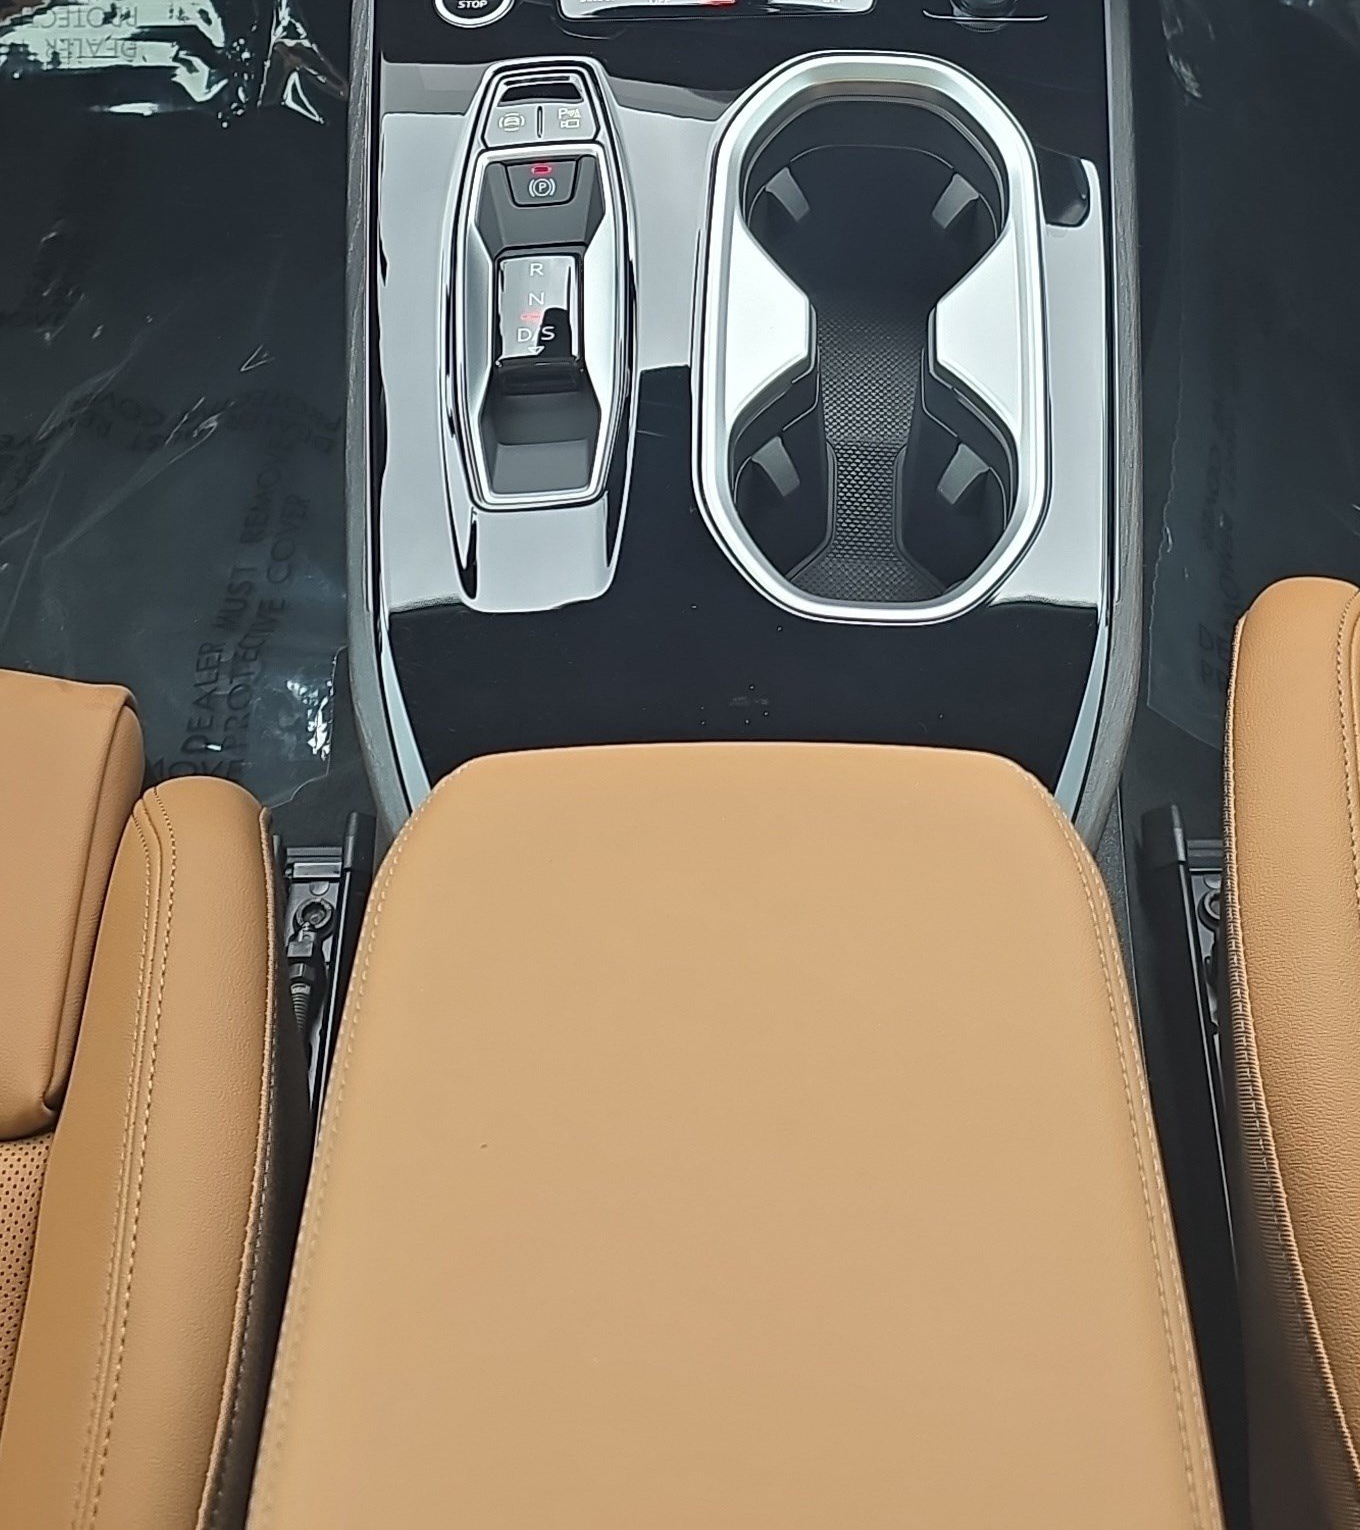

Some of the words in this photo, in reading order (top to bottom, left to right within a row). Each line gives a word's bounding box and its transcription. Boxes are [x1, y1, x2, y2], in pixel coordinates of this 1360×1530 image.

[457, 0, 488, 9] STOP
[530, 263, 544, 276] R
[528, 292, 544, 306] N
[517, 326, 556, 343] D/S
[179, 640, 226, 755] DEALER
